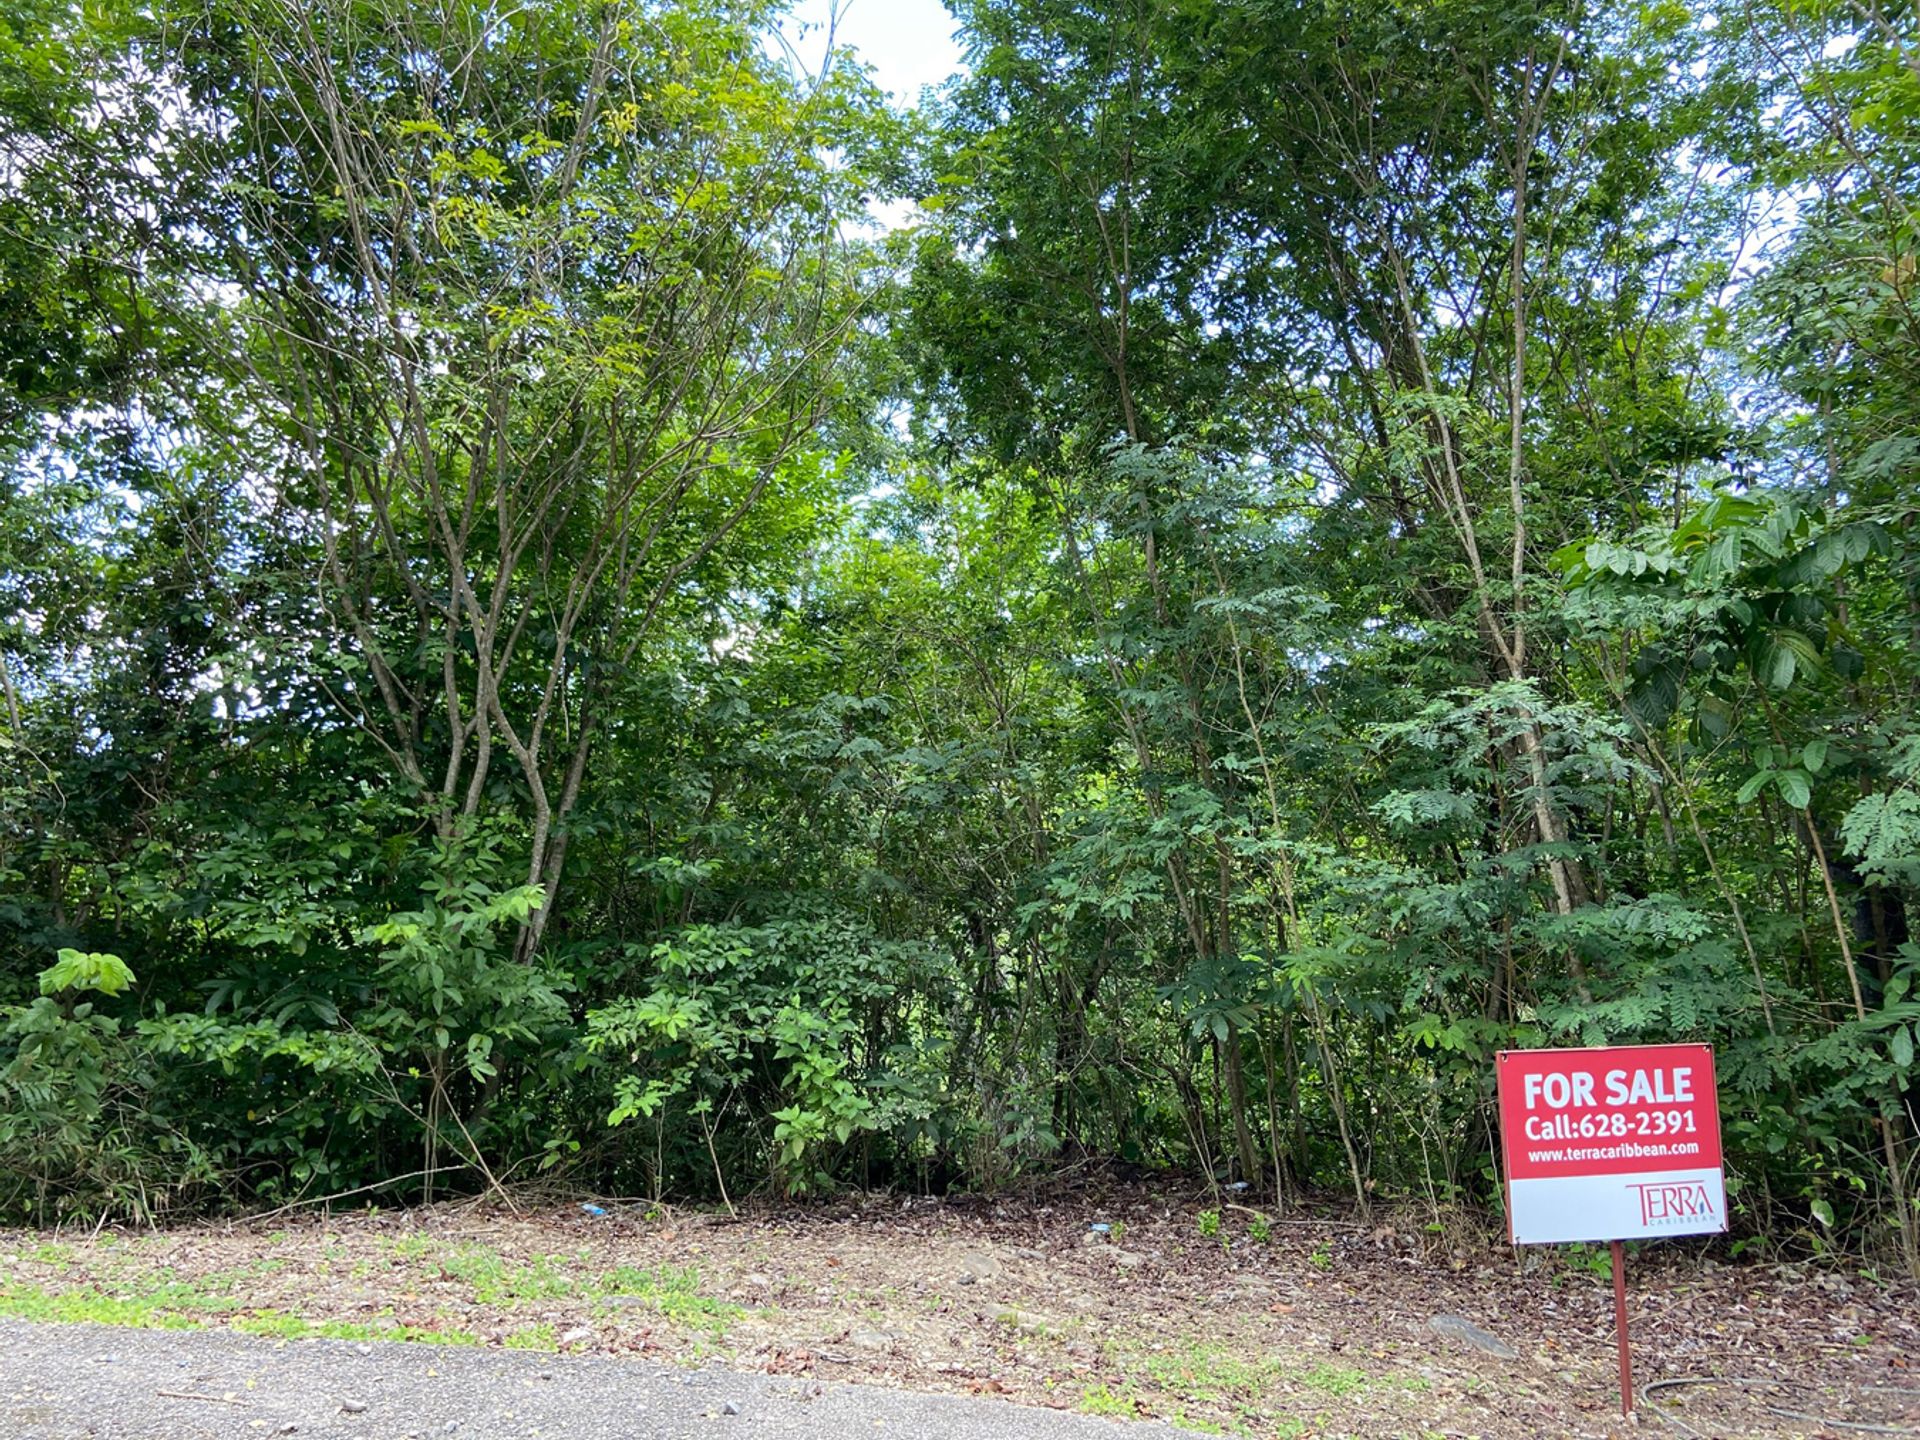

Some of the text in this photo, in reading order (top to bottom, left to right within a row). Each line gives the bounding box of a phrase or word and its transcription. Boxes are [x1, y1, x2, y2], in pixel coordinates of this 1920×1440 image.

[1524, 1067, 1695, 1109] FOR SALE
[1525, 1109, 1697, 1141] Call:628-2391
[1528, 1142, 1699, 1162] www.terracaribbean.com
[1625, 1180, 1714, 1226] TERRA
[1649, 1215, 1716, 1226] CARIBBEAN
